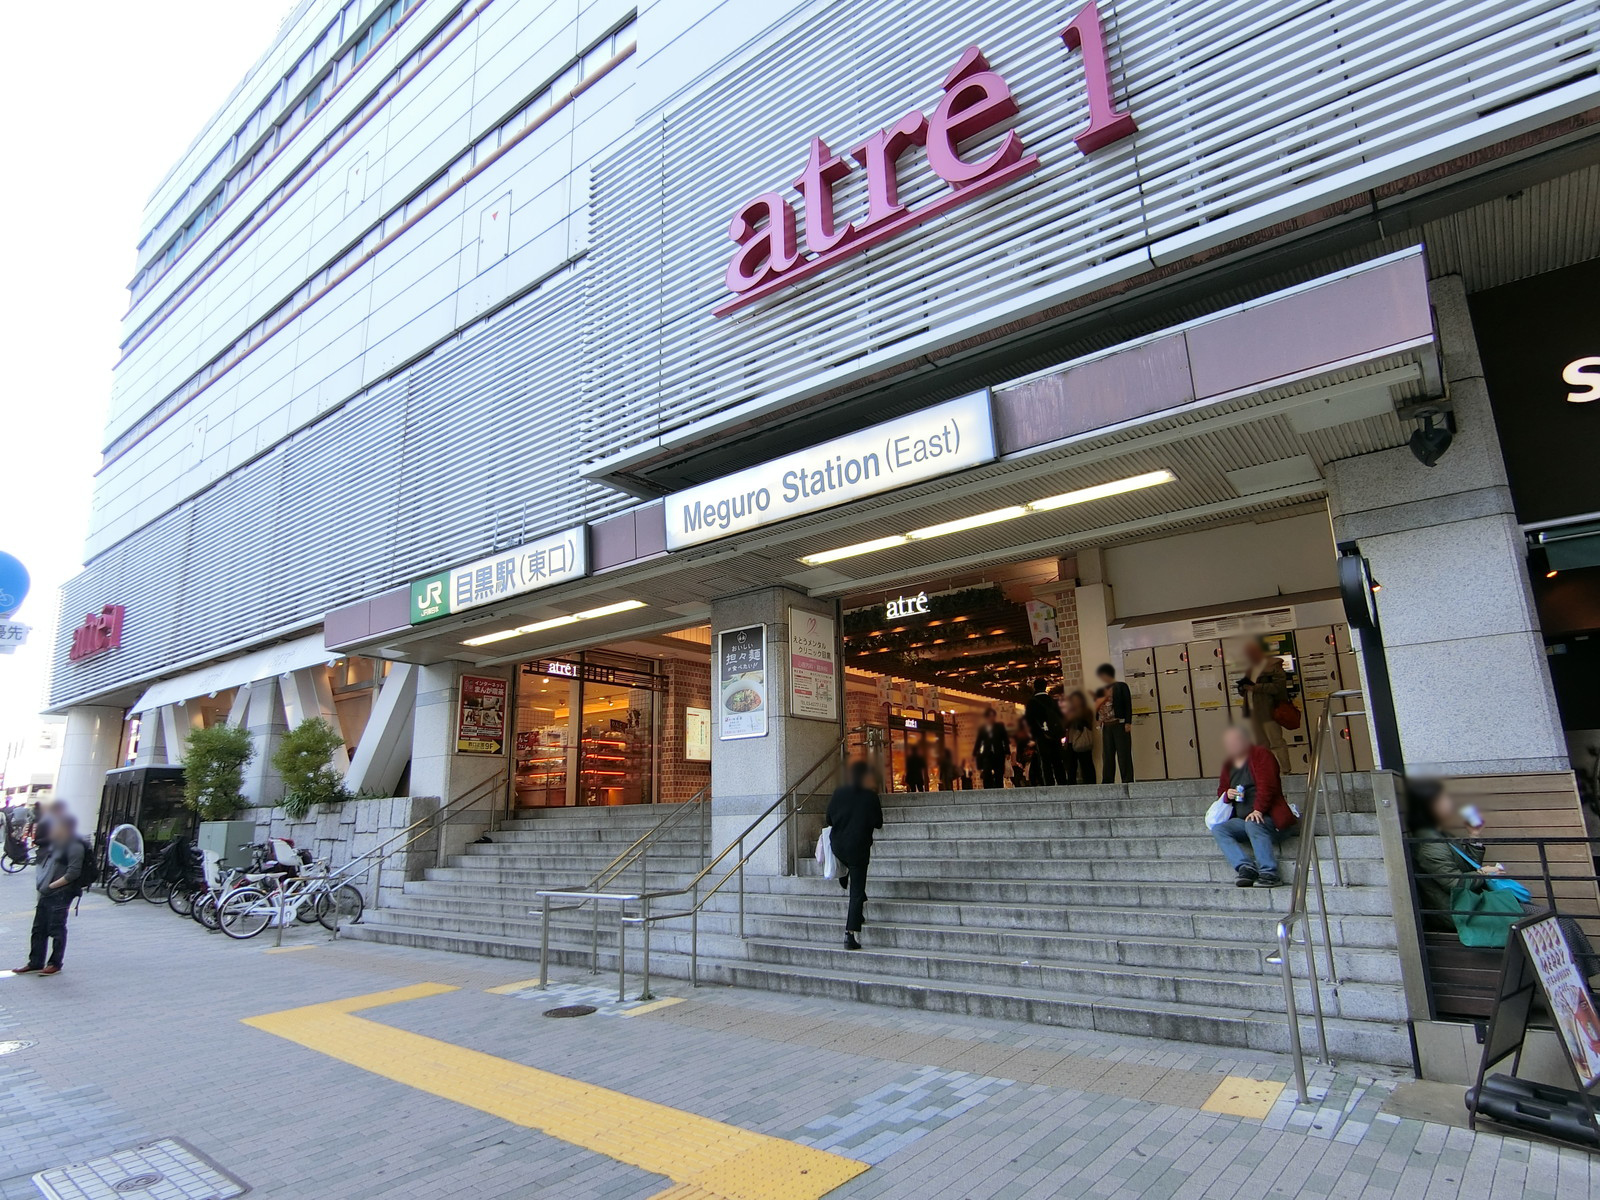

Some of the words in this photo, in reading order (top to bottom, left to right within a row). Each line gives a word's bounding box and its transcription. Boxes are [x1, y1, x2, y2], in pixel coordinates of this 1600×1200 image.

[722, 45, 1028, 300] atré
[1059, 0, 1138, 155] 1
[683, 486, 771, 534] Meguro
[782, 452, 880, 503] Station
[885, 418, 961, 473] (East)
[456, 539, 575, 607] 目黒駅(東口)
[418, 580, 443, 609] JR
[885, 591, 931, 619] atré
[731, 643, 754, 652] おいしい
[793, 635, 827, 650] えとうメンタル
[798, 646, 832, 660] クリニック目黒
[725, 648, 761, 666] 担々麺
[547, 661, 572, 677] atré
